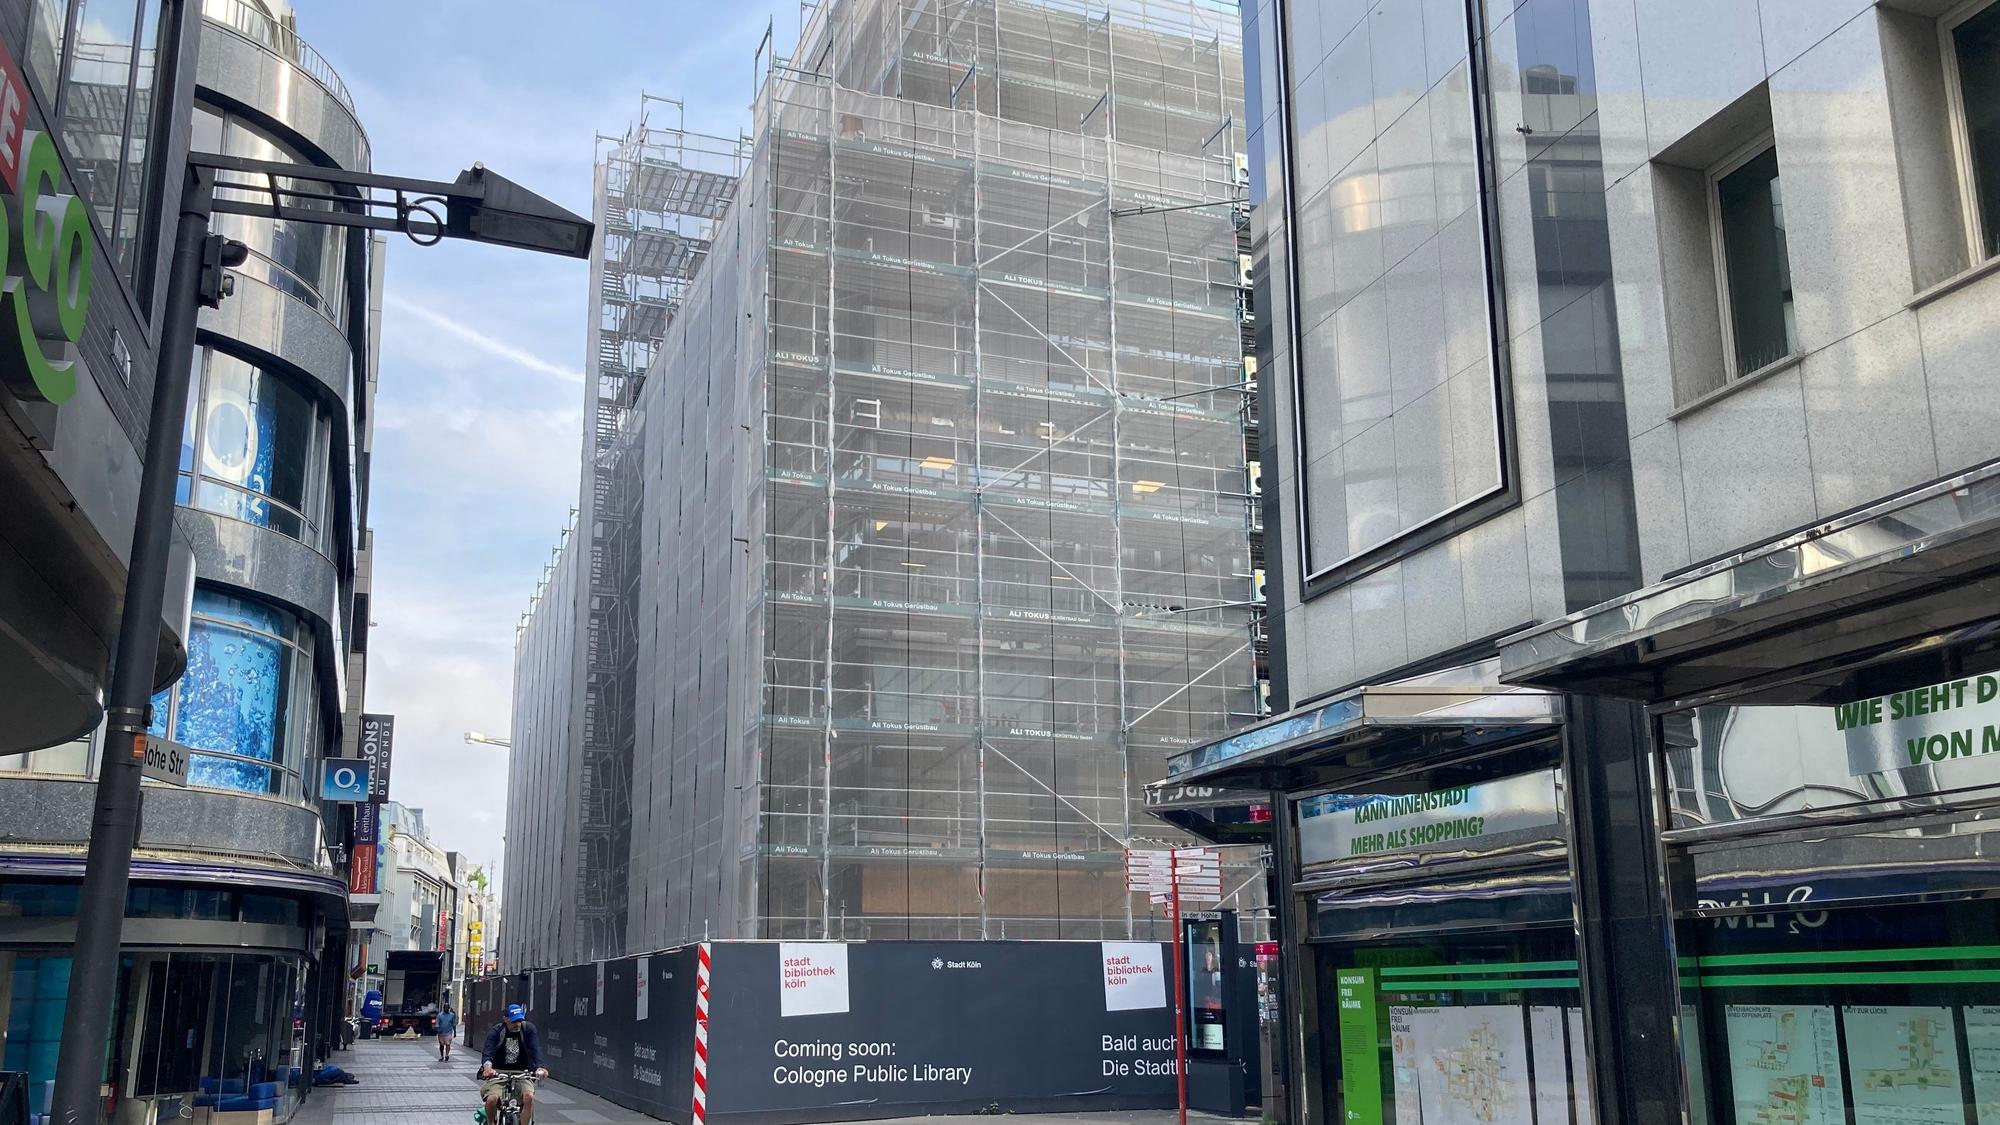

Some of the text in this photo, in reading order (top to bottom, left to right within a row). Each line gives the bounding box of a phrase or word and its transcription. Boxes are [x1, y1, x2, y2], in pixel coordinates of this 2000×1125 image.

[798, 133, 817, 142] Tokus
[883, 147, 901, 156] Tokus
[795, 240, 814, 249] Tokus
[883, 255, 901, 264] Tokus
[792, 471, 812, 480] Tokus
[883, 484, 902, 493] Tokus
[792, 593, 812, 602] Tokus
[883, 601, 902, 609] Tokus
[1834, 698, 1883, 731] WIE
[1890, 679, 1968, 721] SIEHT
[789, 717, 810, 725] Tokus
[883, 722, 902, 730] Tokus
[1024, 729, 1052, 737] TOKUS
[381, 722, 391, 769] MONDE
[1907, 729, 1972, 765] VON
[168, 750, 184, 776] Str.
[1354, 785, 1470, 825] KANN INNENSTADT
[1351, 815, 1484, 856] MEHR ALS SHOPPING?
[787, 846, 807, 854] Tokus
[784, 957, 811, 967] stadt
[947, 960, 982, 969] Stadt Köln
[1106, 956, 1130, 966] stadt
[784, 966, 836, 978] bibliothek
[1107, 964, 1153, 975] bibliothek
[785, 978, 806, 989] köln
[1108, 976, 1127, 986] köln
[1340, 976, 1364, 985] KONSUM
[1341, 988, 1353, 997] FREI
[1391, 1008, 1414, 1016] KONSUM
[1102, 1034, 1137, 1051] Bald
[774, 1039, 896, 1061] Coming soon:
[1102, 1059, 1129, 1076] Die
[773, 1064, 972, 1088] Cologne Public Library
